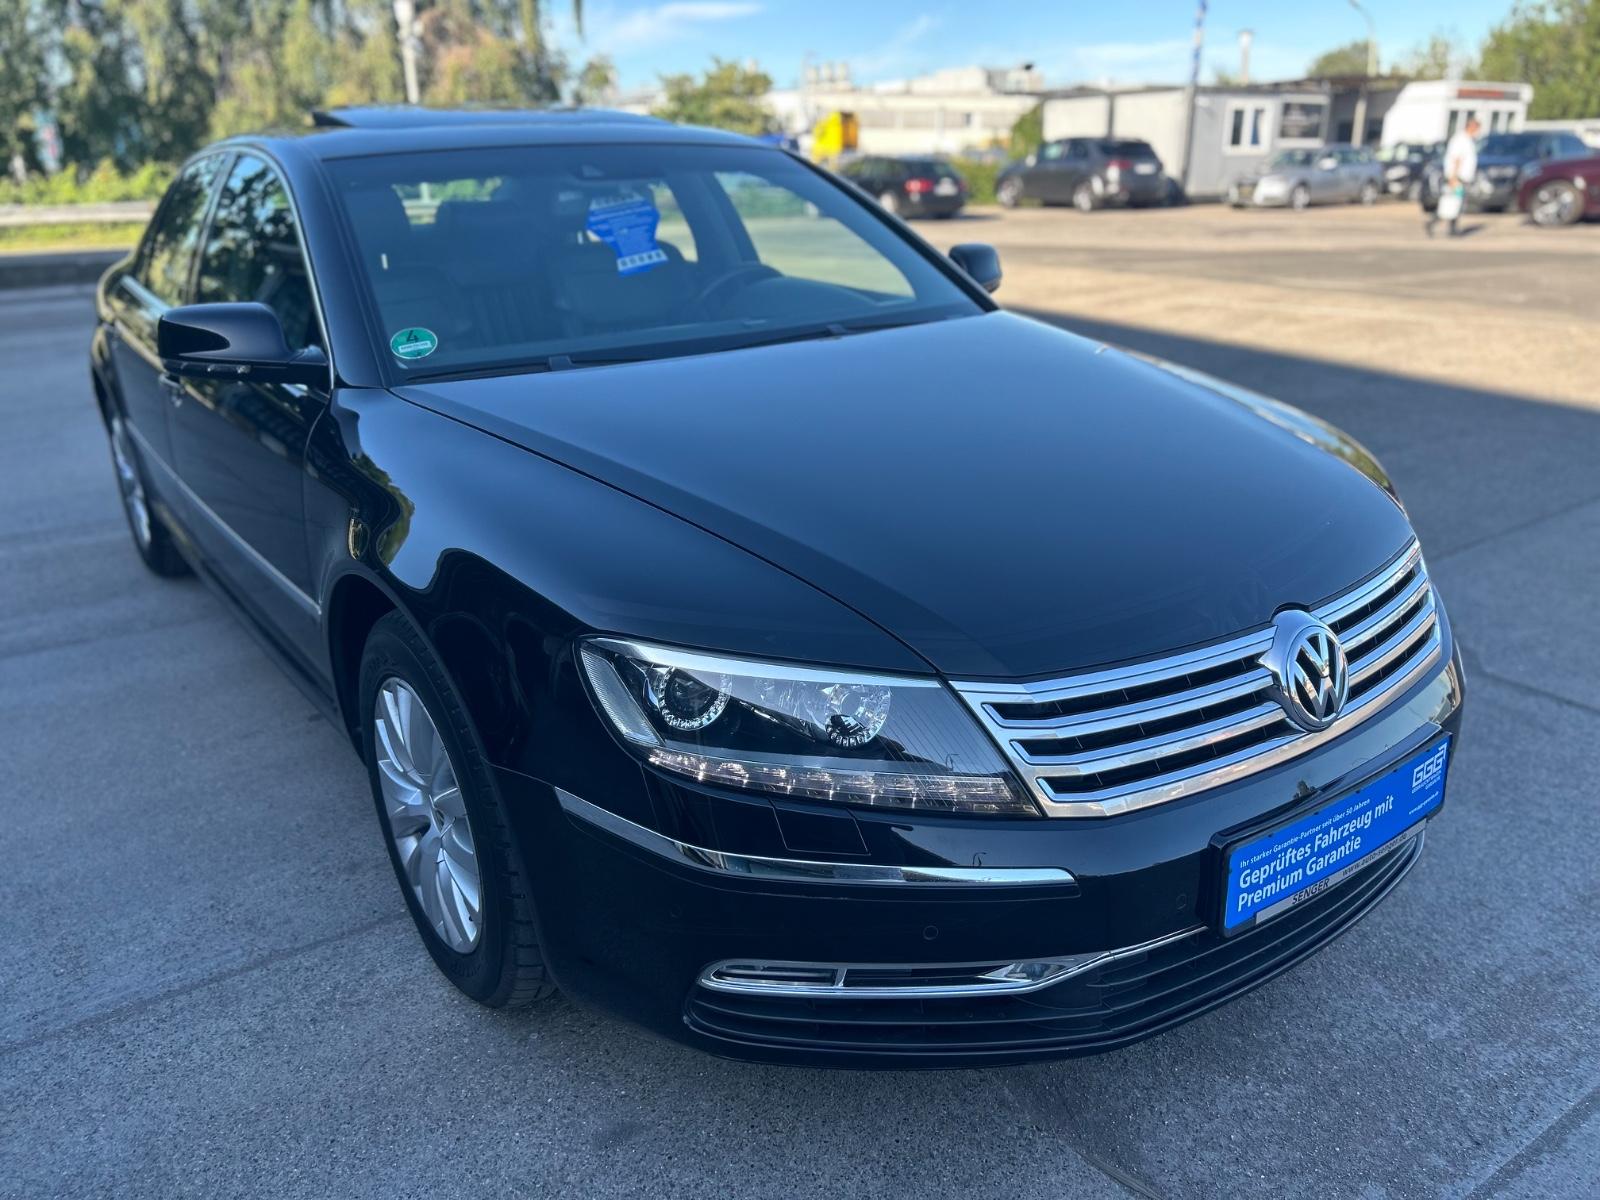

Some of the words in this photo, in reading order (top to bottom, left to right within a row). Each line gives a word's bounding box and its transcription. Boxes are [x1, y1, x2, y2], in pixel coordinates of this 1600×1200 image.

[406, 329, 419, 343] 4
[1412, 748, 1446, 788] GGG
[1239, 842, 1311, 889] Geprüftes
[1314, 811, 1372, 853] Fahrzeug
[1374, 794, 1394, 819] mit
[1240, 858, 1250, 868] Ihr
[1250, 849, 1272, 864] starker
[1273, 825, 1322, 853] Garantie-Partner
[1322, 817, 1332, 828] seit
[1332, 811, 1346, 825] über
[1353, 798, 1371, 813] Jahren
[1237, 867, 1303, 913] Premium
[1306, 835, 1362, 876] Garantie
[1291, 878, 1330, 905] SENGER
